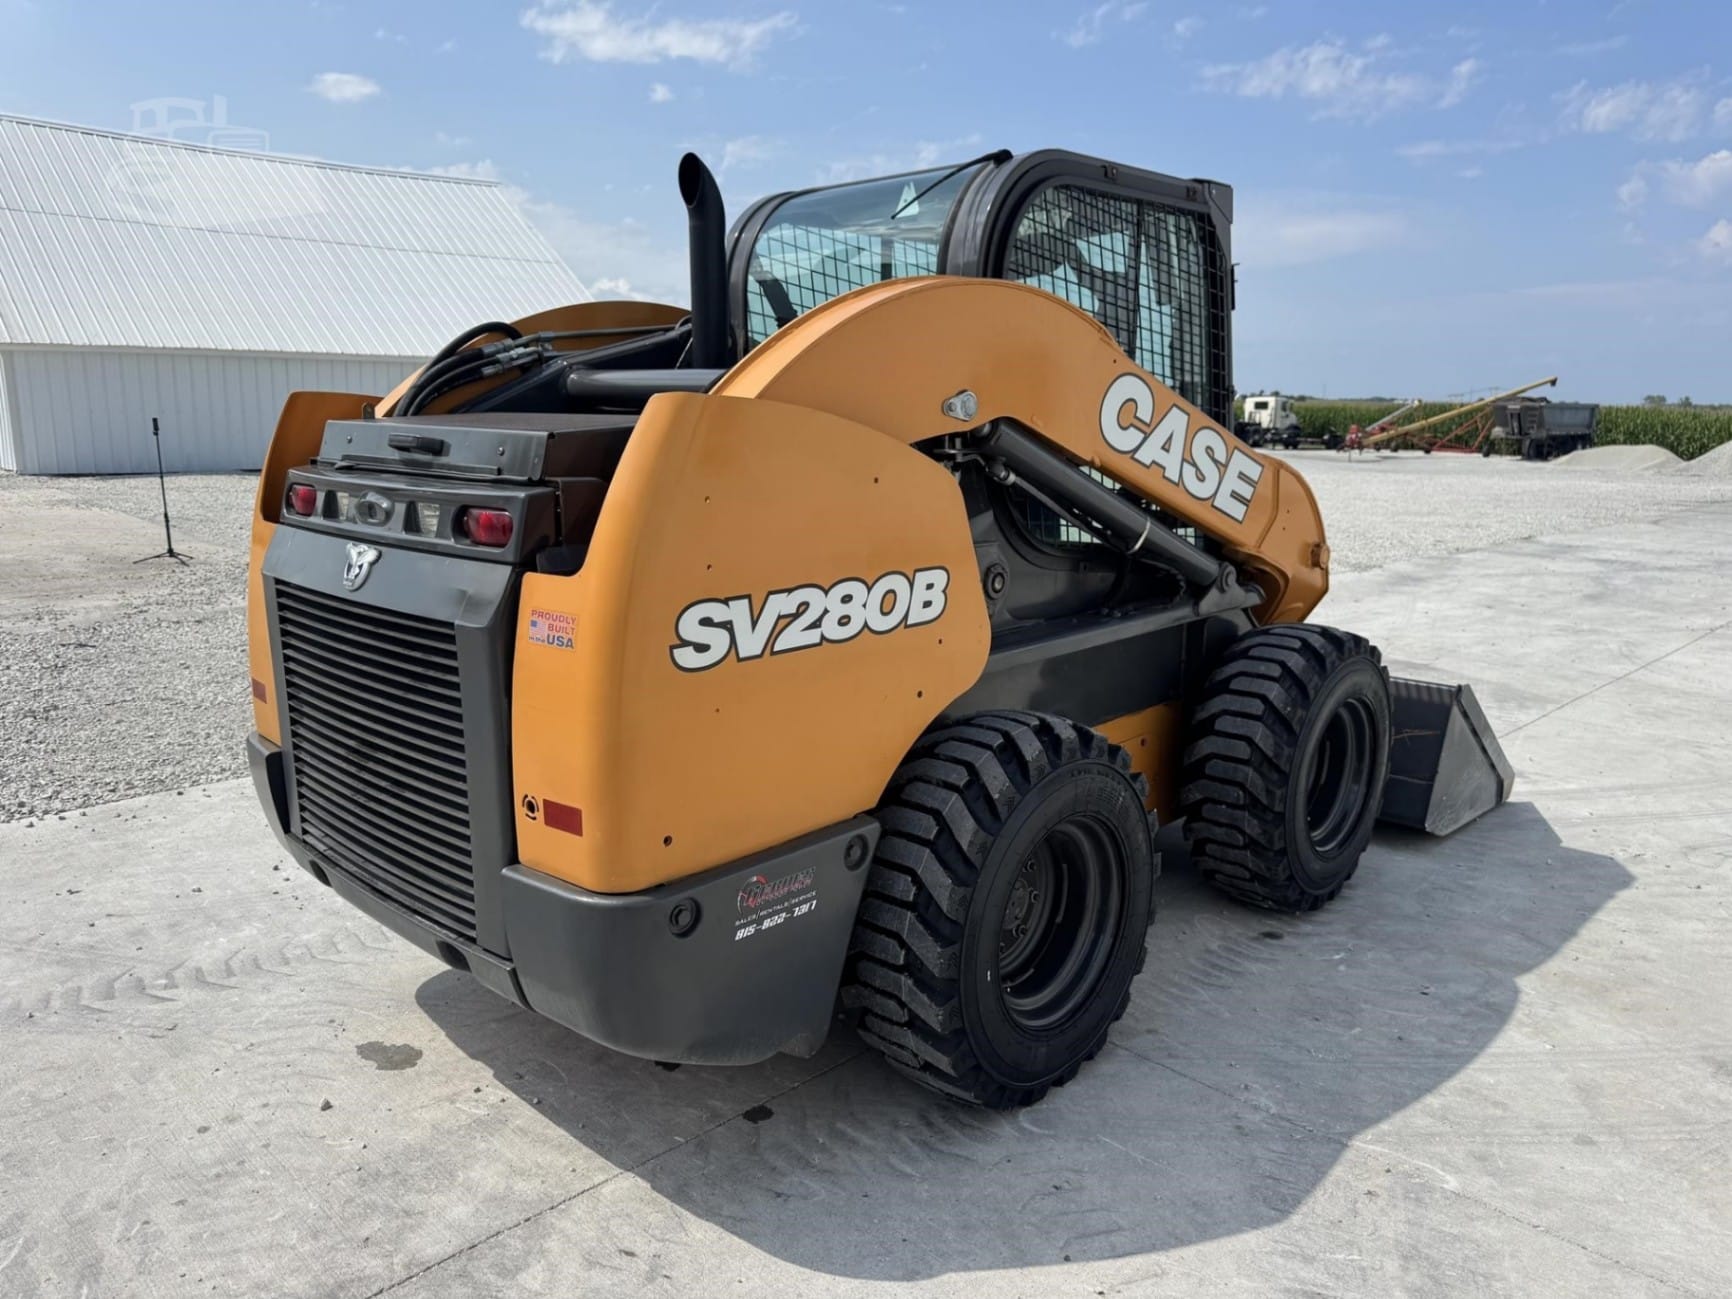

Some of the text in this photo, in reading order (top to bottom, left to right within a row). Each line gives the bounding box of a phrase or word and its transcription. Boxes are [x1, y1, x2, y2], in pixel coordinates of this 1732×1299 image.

[1099, 372, 1264, 524] CASE
[531, 610, 576, 625] PROUDLY
[669, 566, 950, 673] SV280B
[548, 624, 575, 635] BUILT
[547, 634, 575, 649] USA
